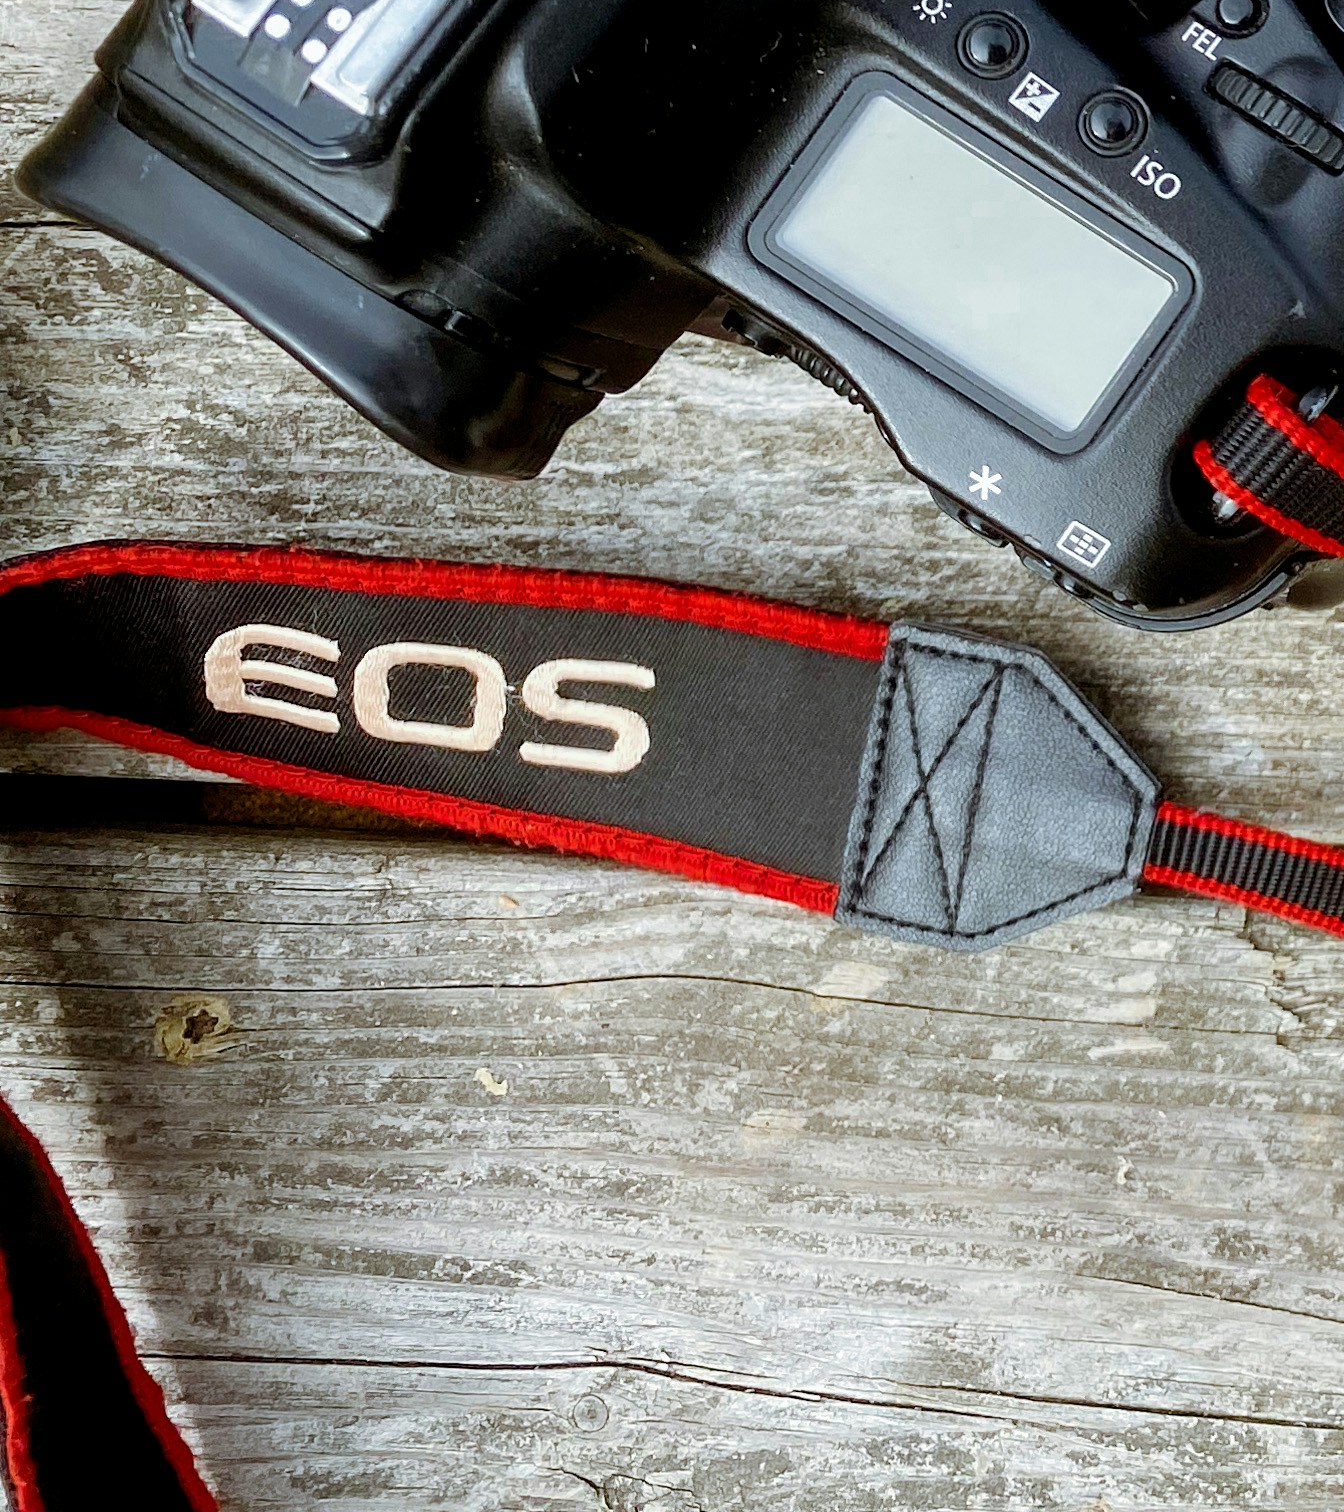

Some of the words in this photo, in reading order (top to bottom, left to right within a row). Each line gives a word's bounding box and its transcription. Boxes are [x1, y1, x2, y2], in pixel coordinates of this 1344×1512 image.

[1181, 21, 1223, 61] FEL
[1130, 153, 1182, 200] ISO
[204, 623, 655, 774] EOS
